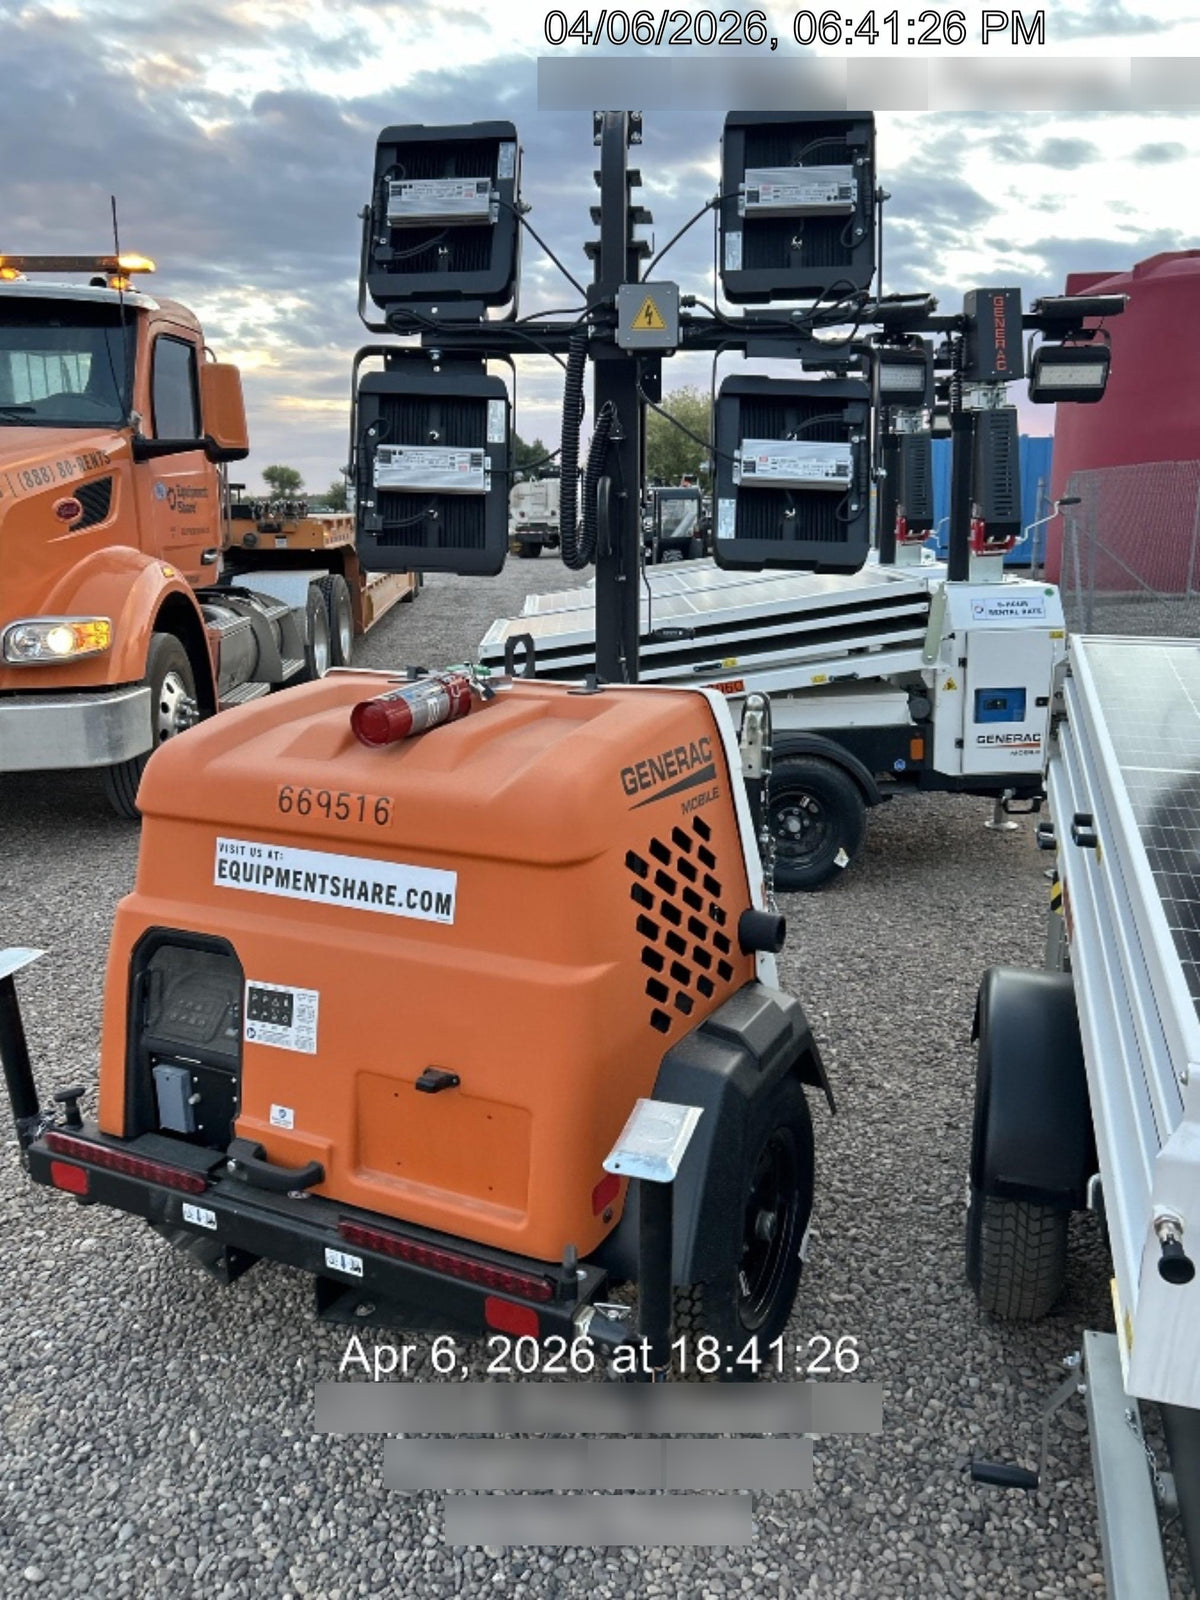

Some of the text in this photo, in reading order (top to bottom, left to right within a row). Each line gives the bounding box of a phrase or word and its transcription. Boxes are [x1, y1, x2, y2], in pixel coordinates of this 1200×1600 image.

[993, 296, 1007, 371] GENERAC
[17, 450, 111, 491] (888) 80-RENTS
[976, 733, 1041, 745] GENERAC
[621, 737, 712, 796] GENERAC
[278, 785, 391, 826] 669516
[681, 787, 720, 815] MOBILE
[219, 842, 246, 856] VISIT
[250, 847, 262, 858] US
[218, 858, 453, 916] EQUIPMENTSHARE.COM
